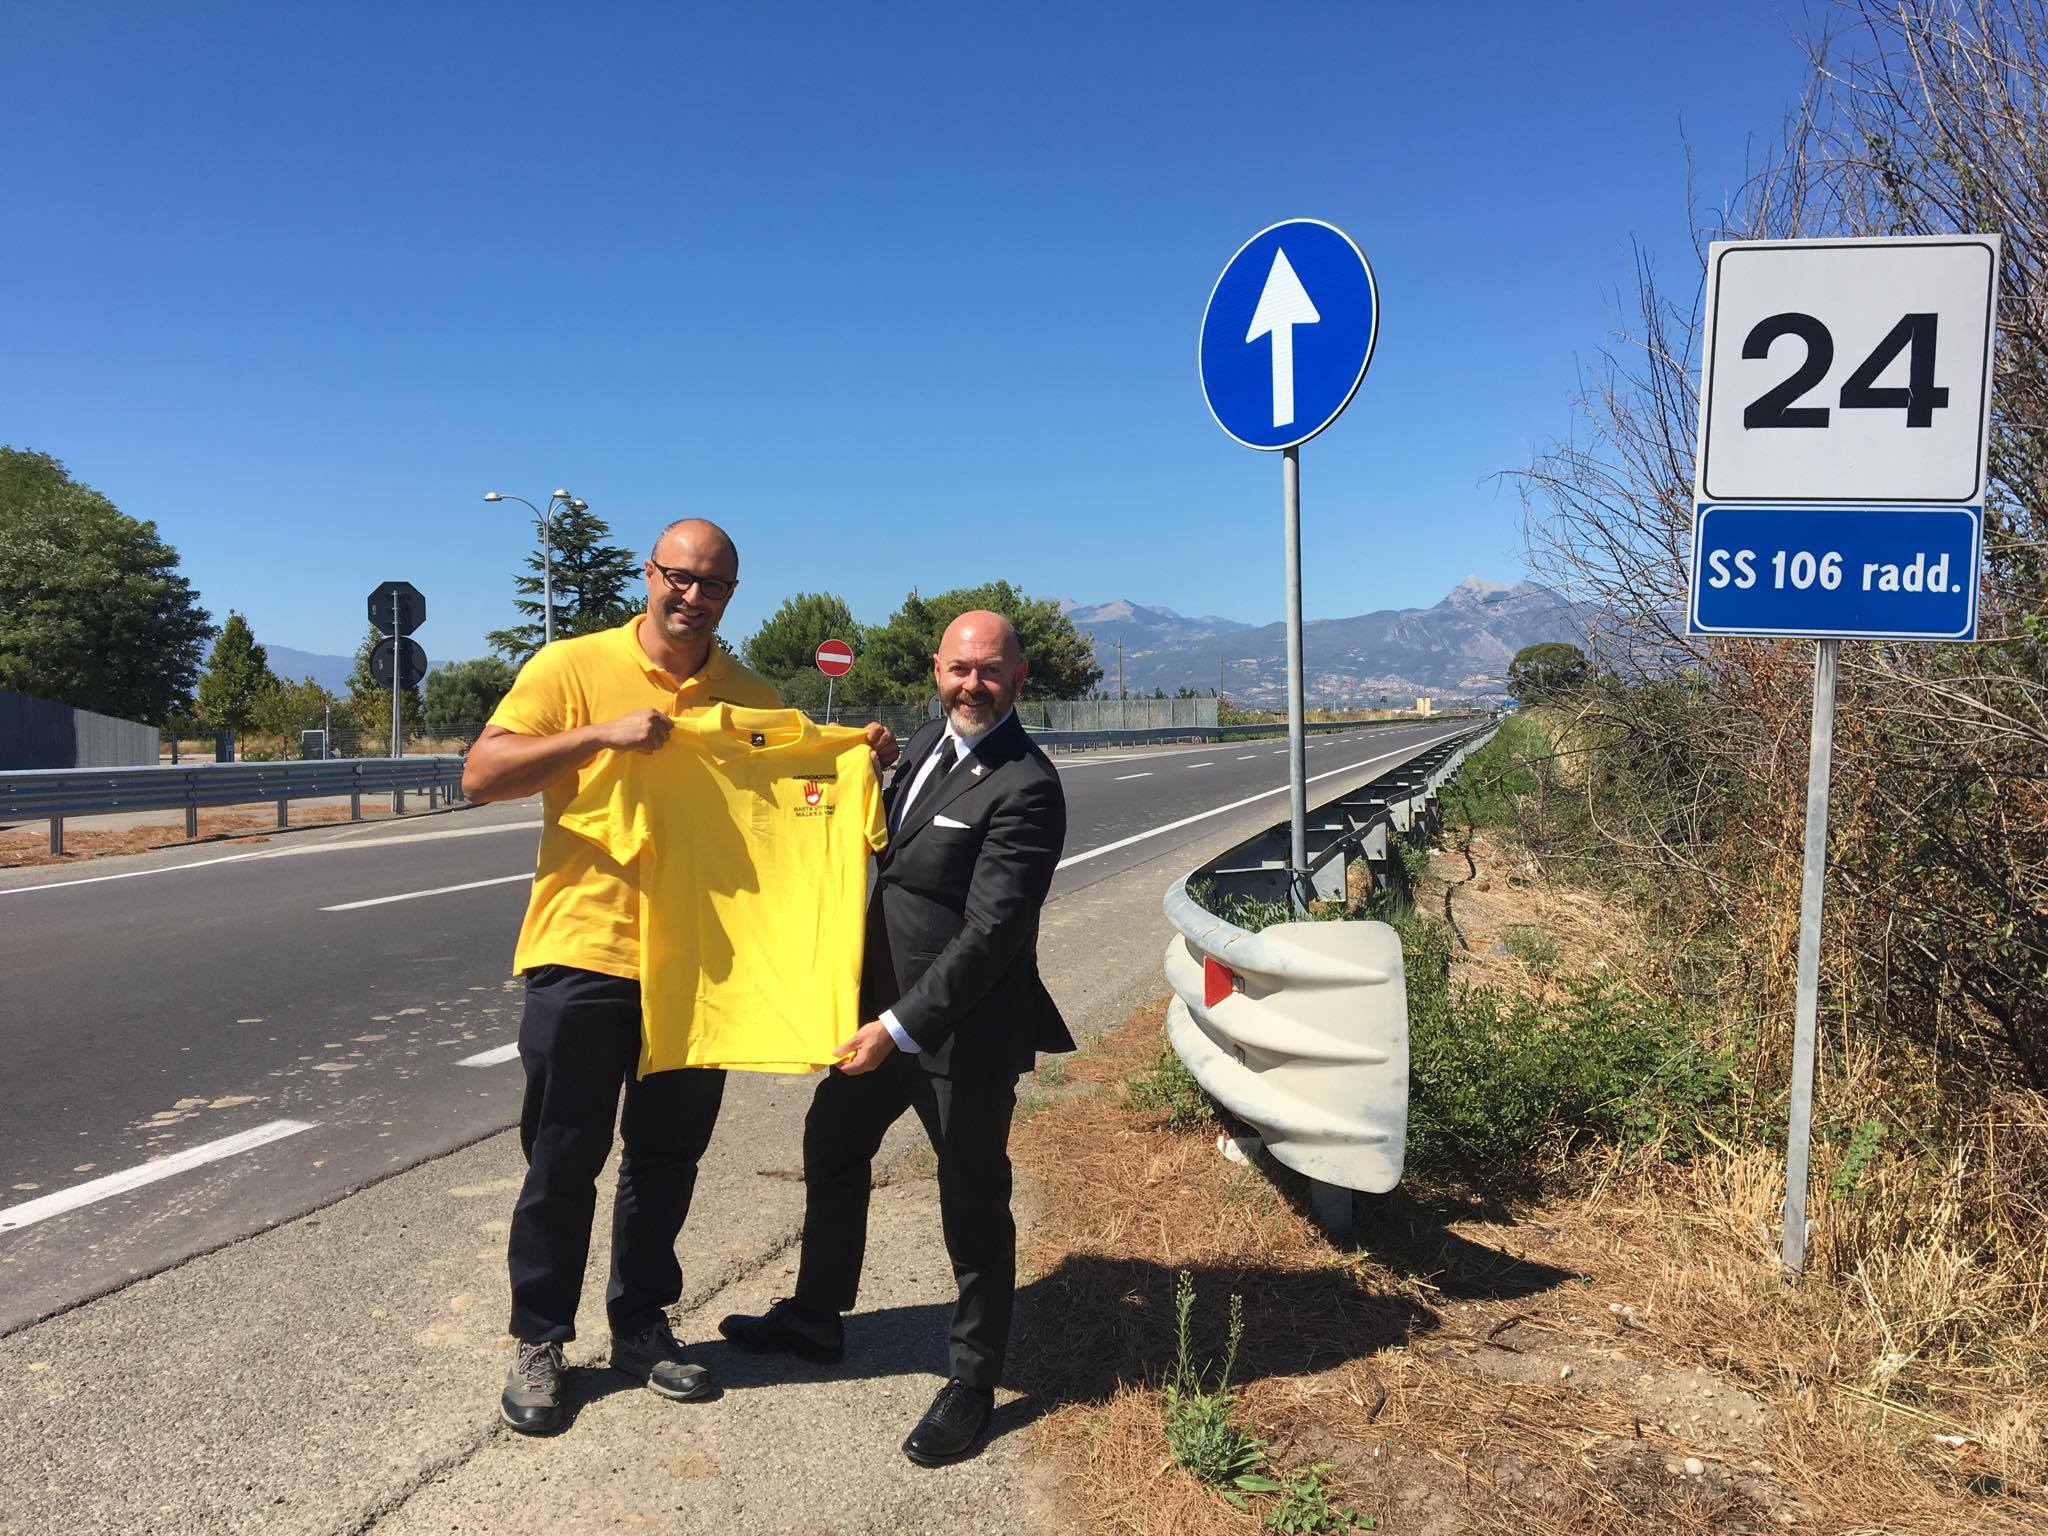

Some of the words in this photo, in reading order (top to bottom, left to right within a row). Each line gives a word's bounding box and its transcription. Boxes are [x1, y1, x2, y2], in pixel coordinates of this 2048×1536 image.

[1741, 312, 1949, 429] 24
[1708, 549, 1757, 589] SS
[1772, 551, 1842, 590] 106
[1861, 552, 1961, 593] radd.
